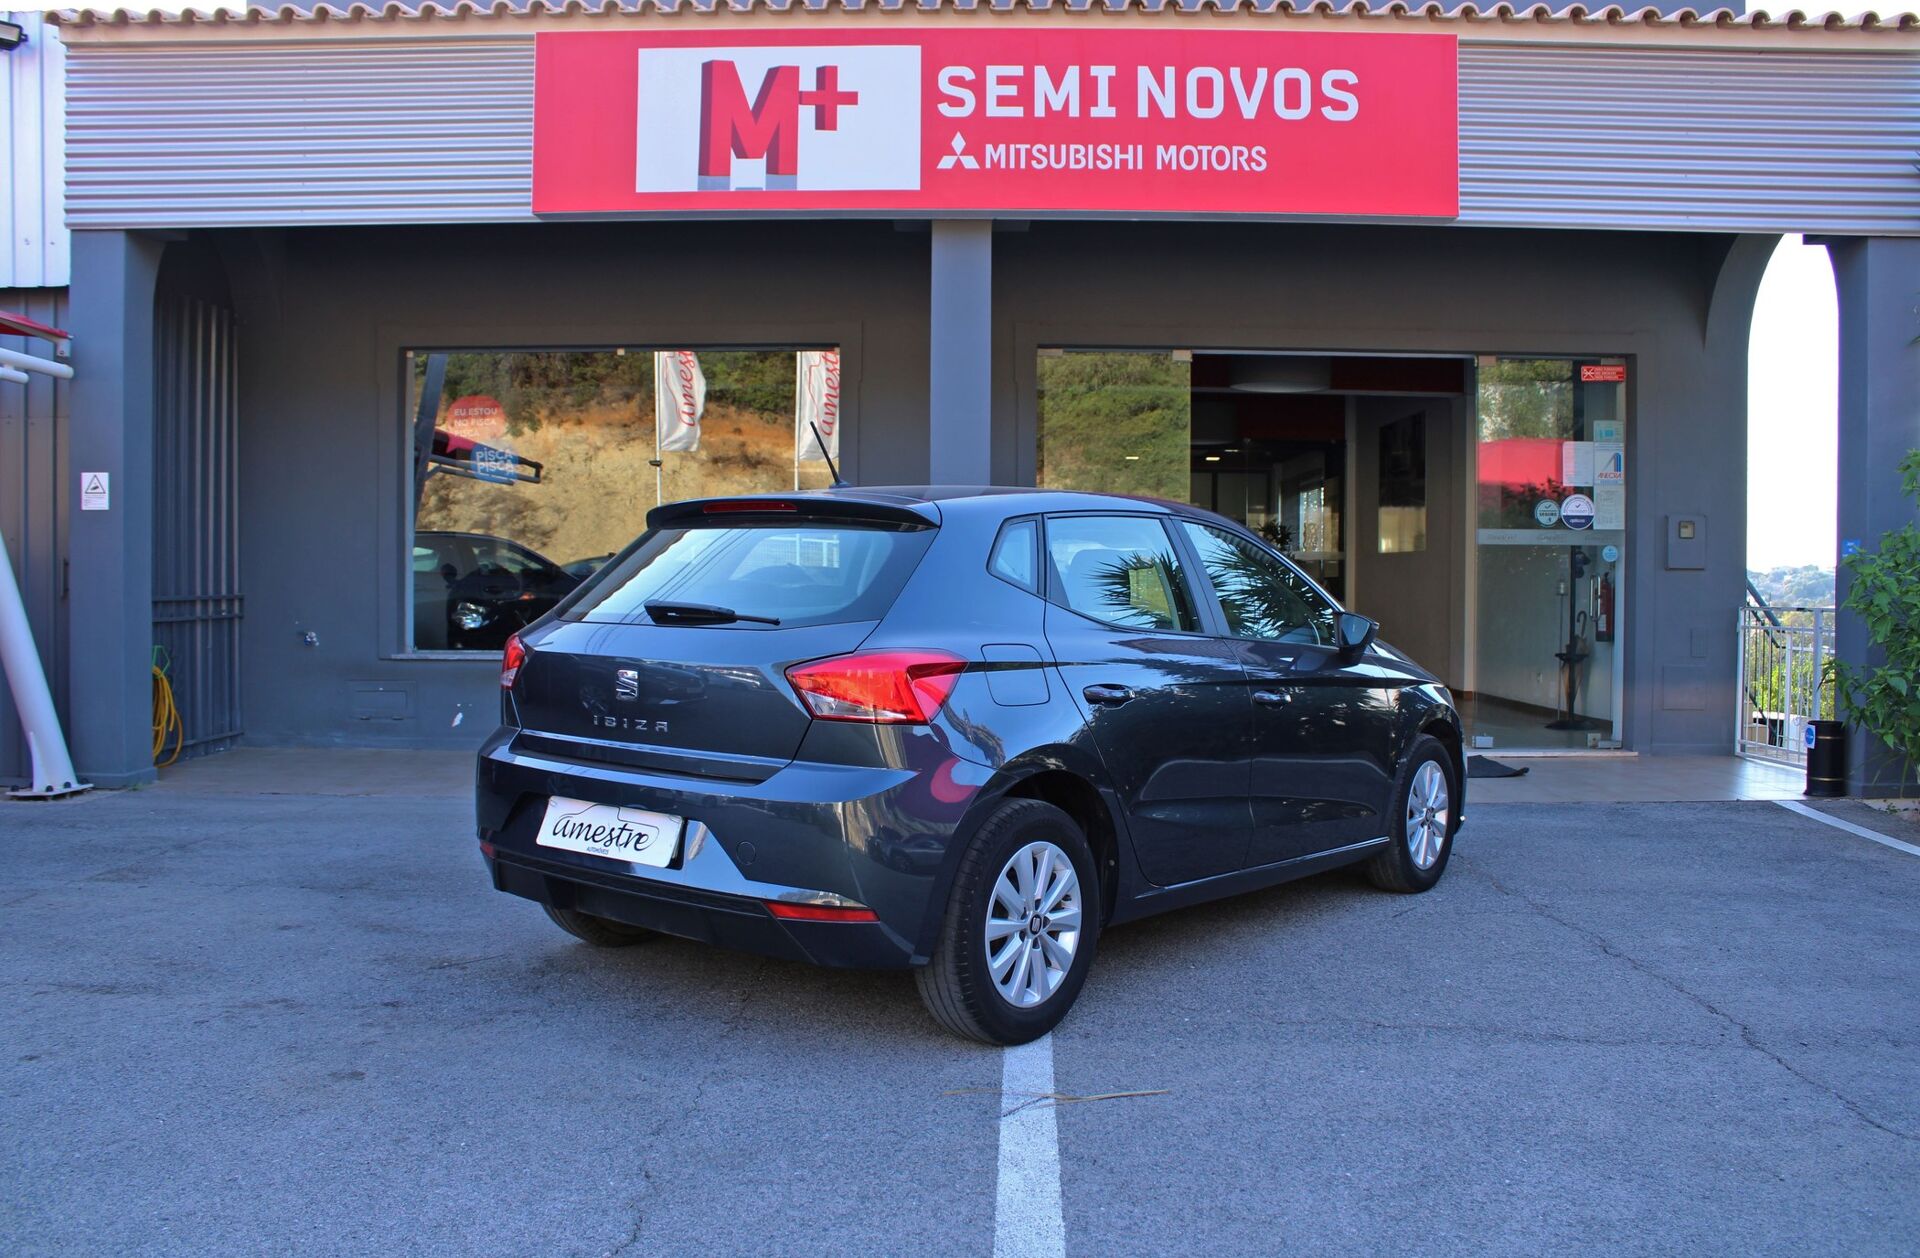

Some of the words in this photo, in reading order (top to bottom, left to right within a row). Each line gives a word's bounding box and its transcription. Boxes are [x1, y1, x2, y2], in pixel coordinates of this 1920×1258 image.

[937, 65, 1116, 118] SEMI
[1137, 66, 1359, 121] NOVOS
[985, 144, 1143, 170] MITSUBISHI
[1156, 145, 1267, 172] MOTORS
[454, 408, 466, 416] EU
[469, 407, 497, 416] ESTOU
[593, 715, 668, 732] IBIZA
[552, 815, 652, 852] amestre
